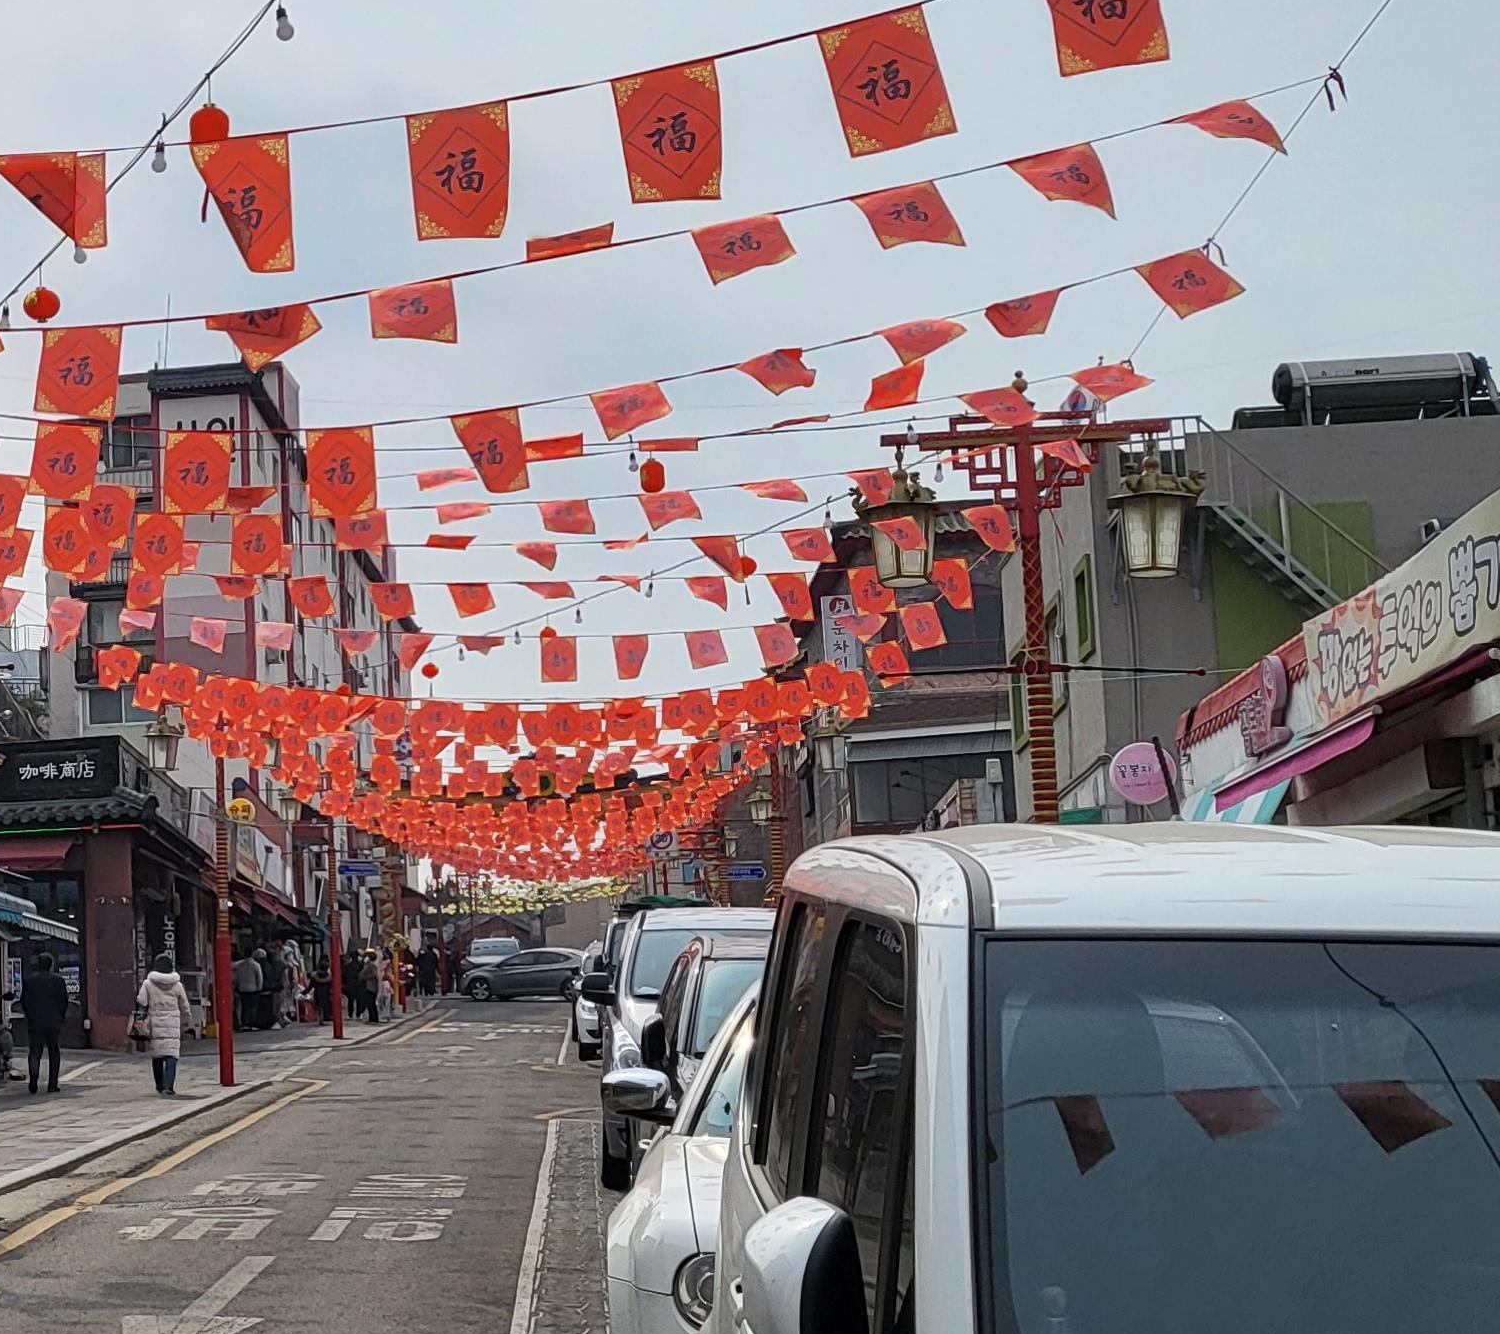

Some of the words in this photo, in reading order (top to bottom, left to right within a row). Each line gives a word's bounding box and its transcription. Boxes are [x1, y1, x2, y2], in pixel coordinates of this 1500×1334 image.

[855, 60, 912, 106] 福
[643, 112, 698, 156] 福
[434, 149, 485, 196] 福
[1379, 580, 1442, 680] 추억의
[19, 759, 95, 780] 咖啡商店
